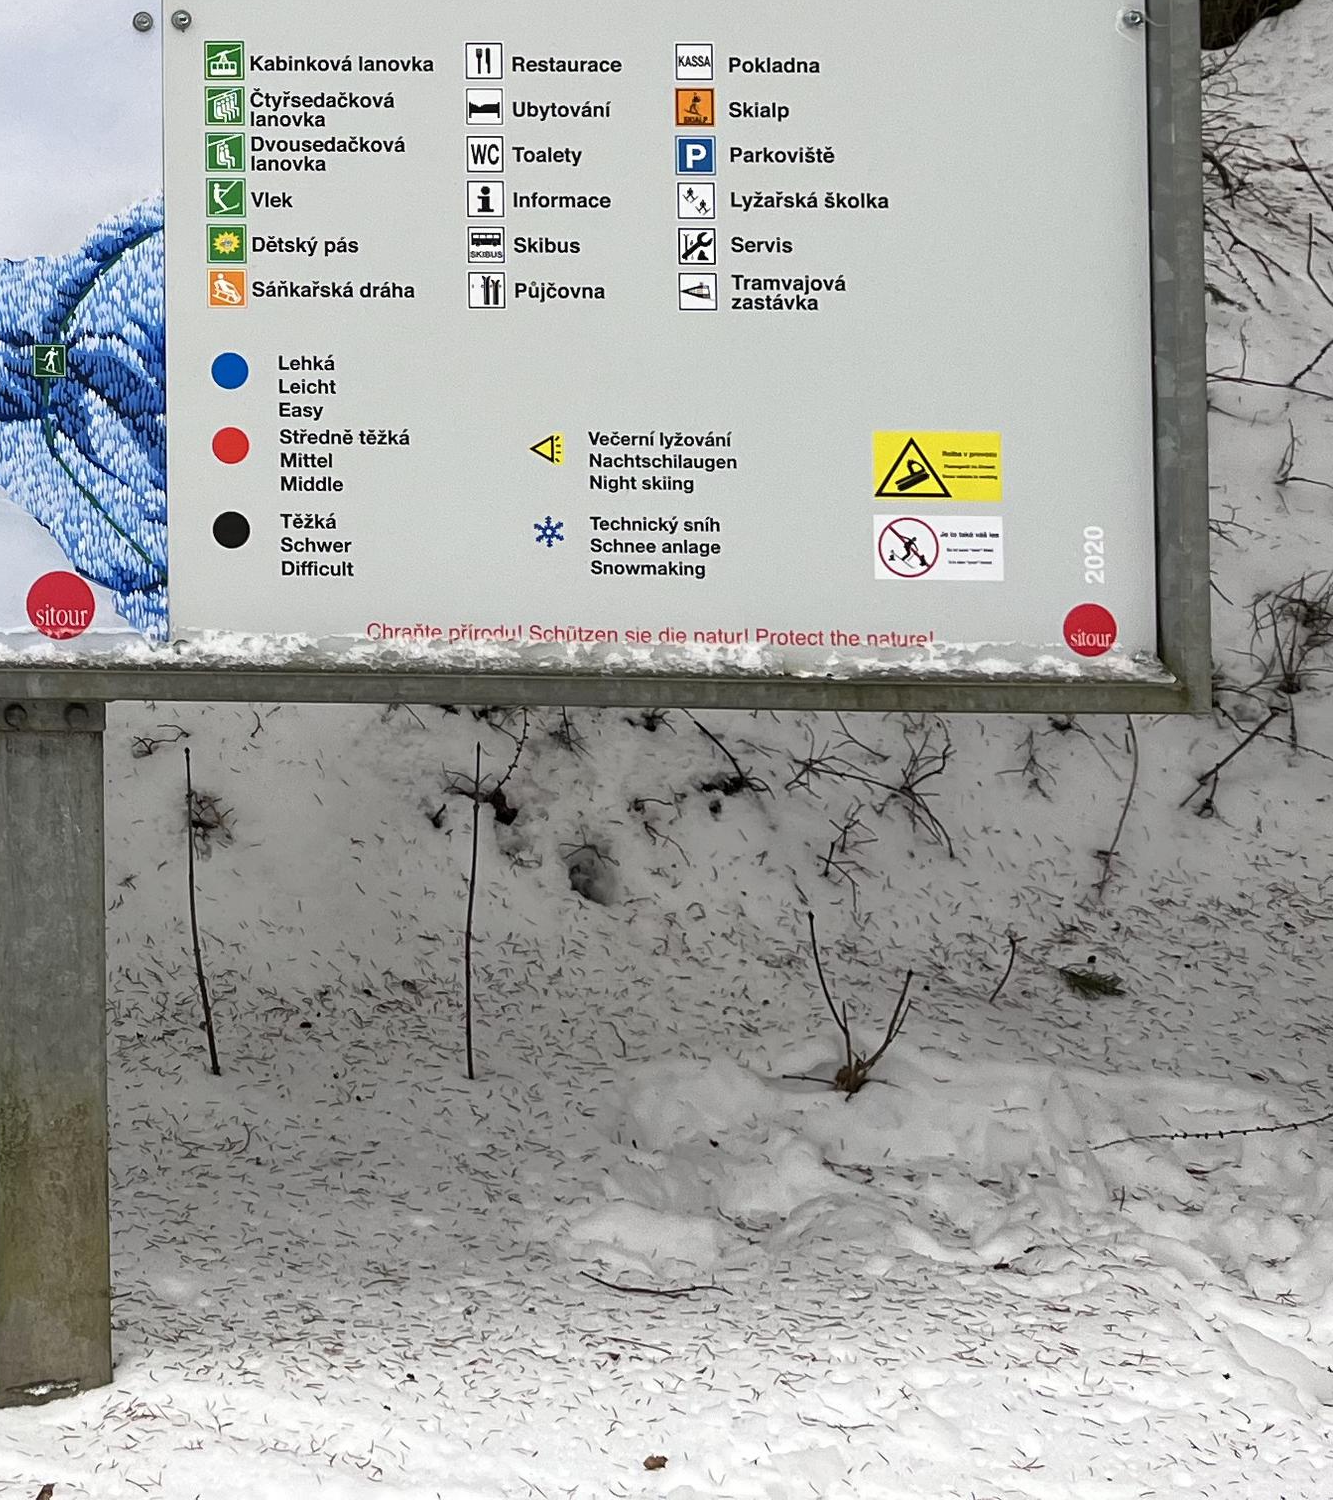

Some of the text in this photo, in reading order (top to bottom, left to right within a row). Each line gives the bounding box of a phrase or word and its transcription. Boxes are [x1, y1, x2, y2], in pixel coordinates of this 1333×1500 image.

[249, 54, 435, 73] Kabinková lanovka
[511, 56, 623, 73] Restaurace
[677, 54, 712, 68] KASSA
[728, 56, 821, 74] Pokladna
[249, 87, 395, 112] Čtyřsedačková
[250, 110, 326, 128] lanovka
[512, 100, 612, 122] Ubytování
[728, 101, 790, 123] Skialp
[250, 135, 406, 153] Dvousedačková
[250, 155, 327, 172] lanovka
[470, 143, 500, 166] WC
[511, 146, 583, 167] Toalety
[729, 145, 836, 164] Parkoviště
[250, 191, 294, 209] Vlek
[512, 191, 612, 209] Informace
[730, 190, 889, 213] Lyžařská školka
[251, 235, 359, 258] Dětský pás
[513, 236, 581, 254] Skibus
[730, 236, 794, 254] Servis
[251, 280, 415, 299] Sáňkařská dráha
[514, 280, 606, 304] Půjčovna
[730, 273, 847, 296] Tramvajová
[731, 293, 819, 311] zastávka
[278, 354, 335, 371] Lehká
[278, 378, 337, 395] Leicht
[278, 401, 324, 422] Easy
[279, 428, 410, 446] Středně těžká
[588, 430, 733, 450] Večerní lyžování
[280, 452, 333, 469] Mittel
[589, 452, 738, 473] Nachtschilaugen
[280, 475, 344, 492] Middle
[589, 474, 694, 494] Night skiing
[279, 512, 337, 530] Těžká
[589, 515, 721, 535] Technický sníh
[280, 536, 353, 554] Schwer
[590, 537, 722, 558] Schnee anlage
[1083, 525, 1105, 584] 2020
[281, 560, 355, 577] Difficult
[590, 559, 706, 580] Snowmaking
[35, 603, 89, 627] sitour
[1070, 628, 1112, 648] sitour
